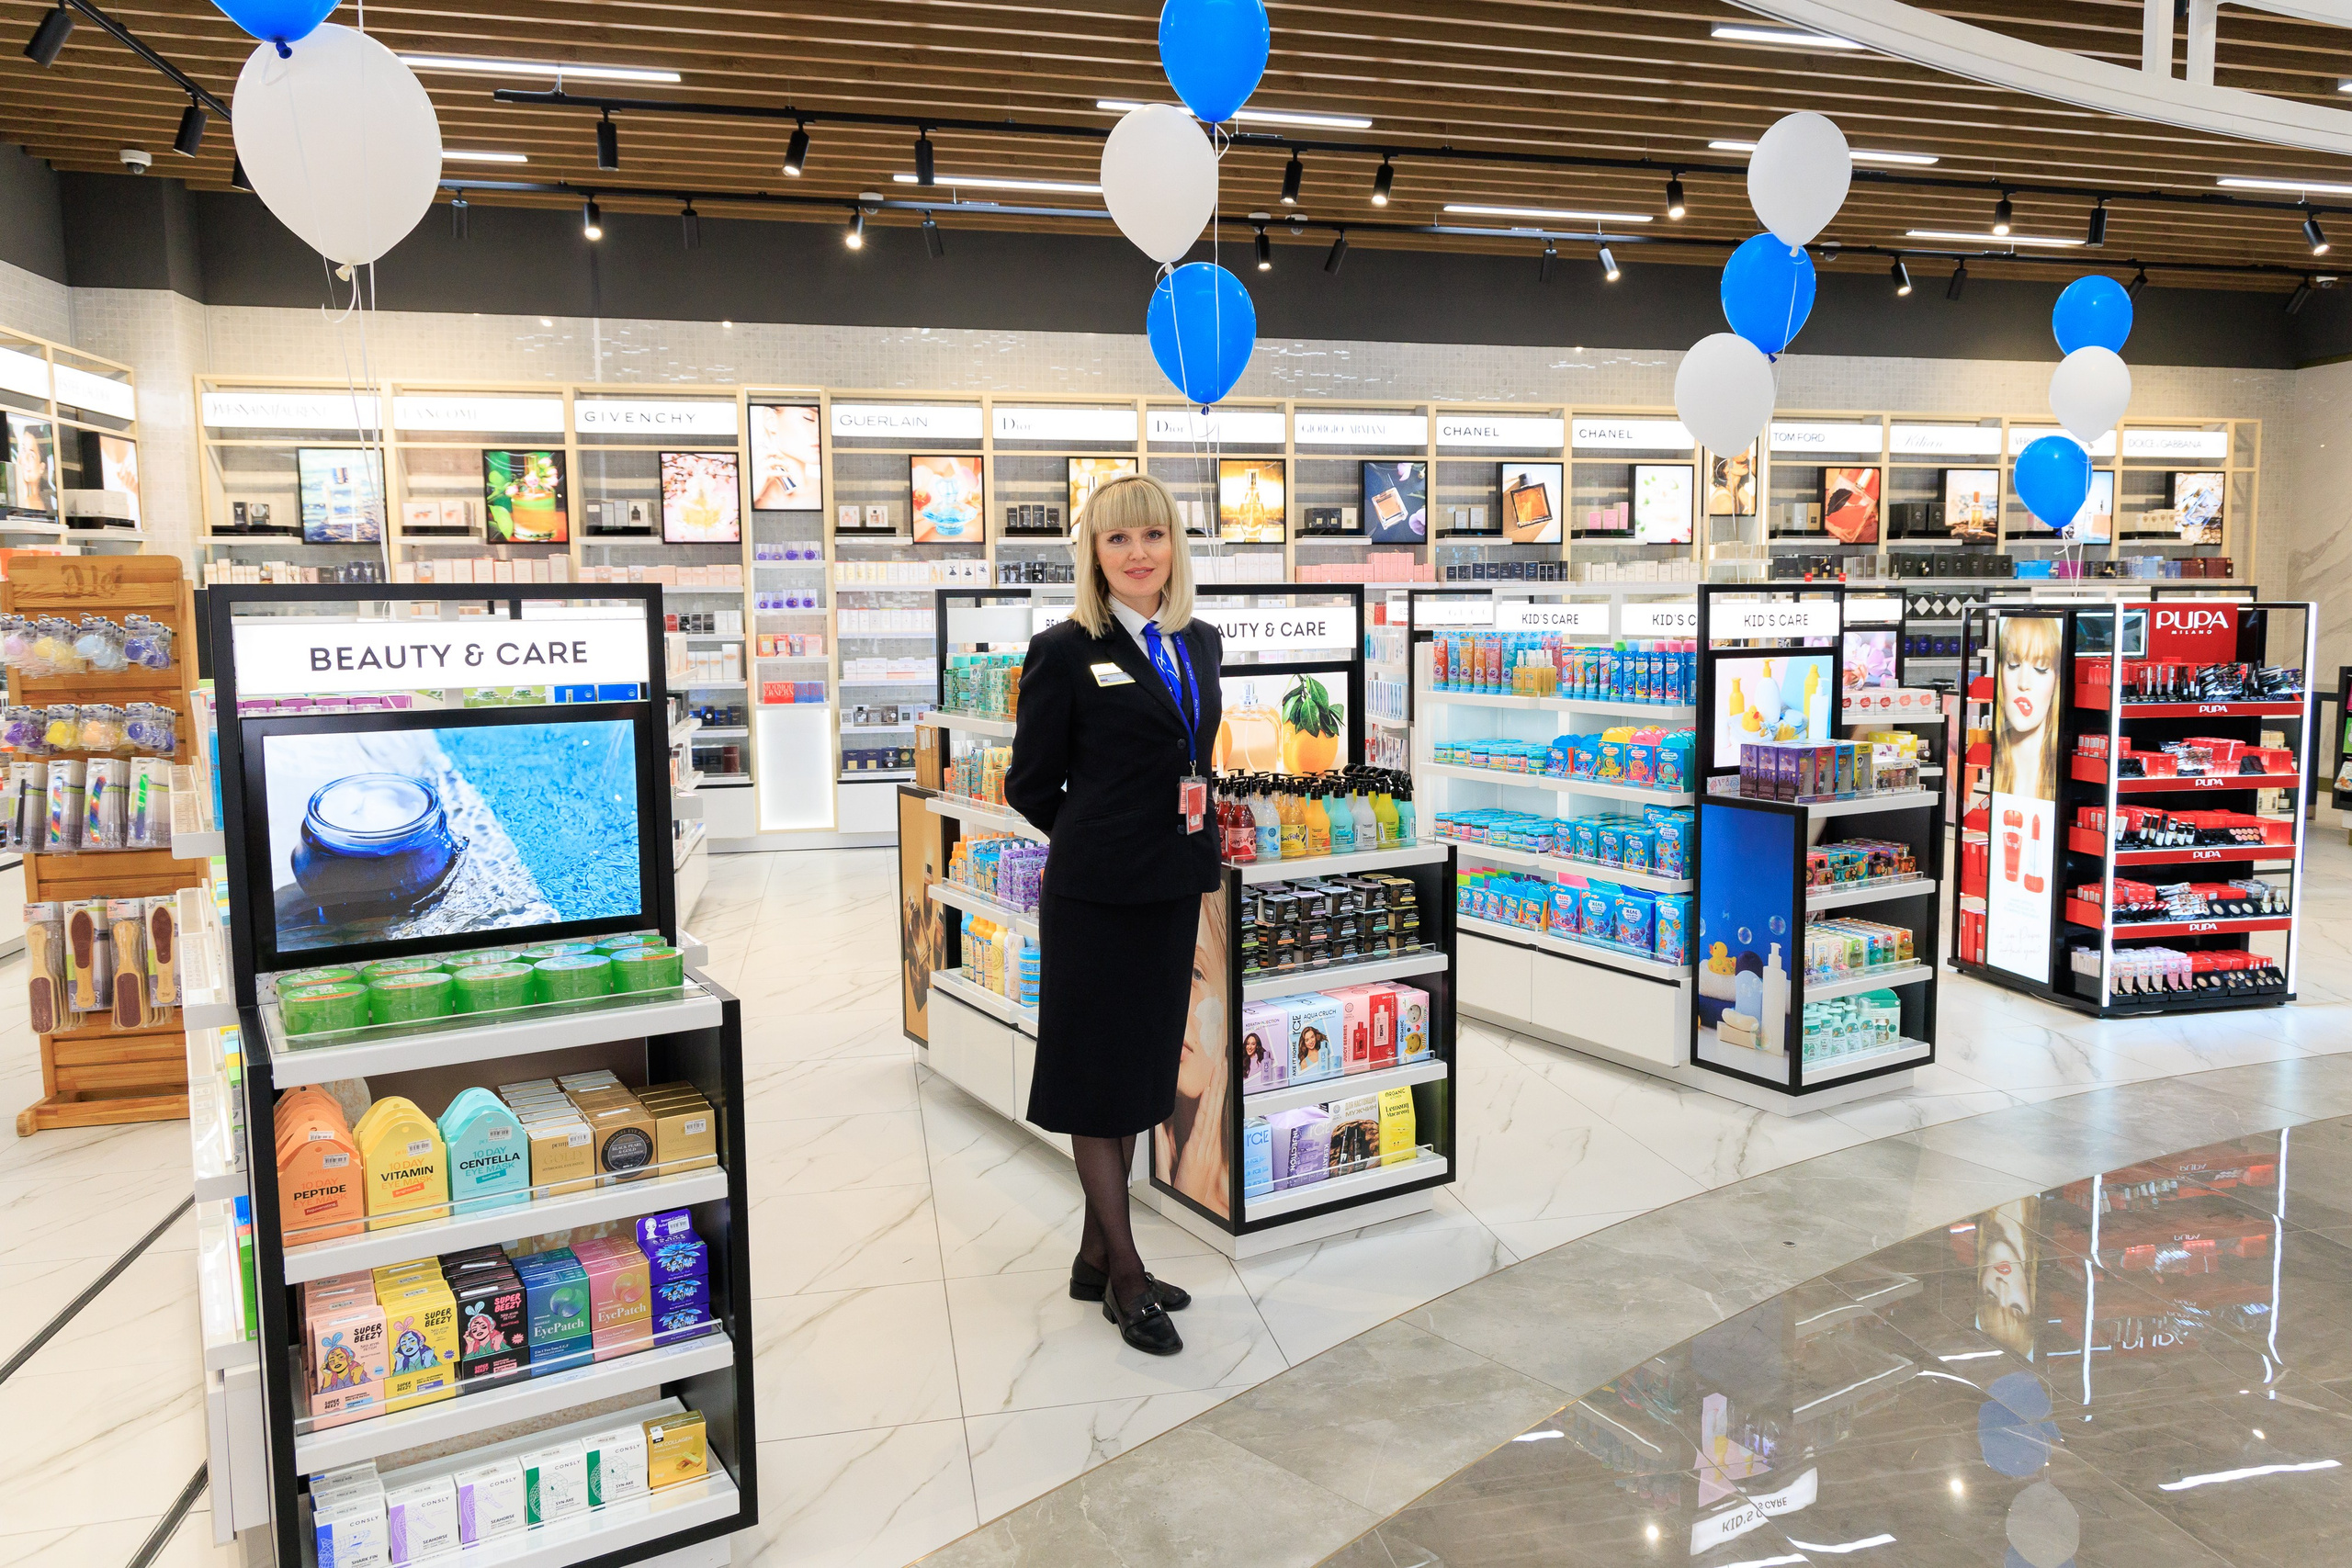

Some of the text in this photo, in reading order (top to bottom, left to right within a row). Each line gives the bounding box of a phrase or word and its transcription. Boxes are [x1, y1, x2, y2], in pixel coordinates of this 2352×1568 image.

[585, 412, 695, 424] GIVENCHY
[840, 414, 928, 428] GUERLAIN
[1002, 417, 1034, 431] Dior
[1156, 420, 1185, 433] Dior
[1301, 423, 1386, 434] GIORGIO ARMANI
[1442, 426, 1499, 437] CHANEL
[1578, 429, 1633, 439] CHANEL
[1772, 432, 1825, 444] TOM FORD
[2128, 438, 2202, 448] DOLCE GABBANA
[1521, 614, 1578, 625] KID'S CARE
[1652, 614, 1684, 626] KID'S
[1744, 614, 1808, 627] KID'S CARE
[2155, 610, 2230, 630] PUPA
[1216, 621, 1326, 638] AUTY & CARE
[311, 640, 588, 671] BEAUTY & CARE
[2199, 705, 2228, 714] PUPA
[2195, 777, 2224, 787] PUPA
[2192, 850, 2222, 860] PUPA
[2188, 922, 2218, 932] PUPA
[1303, 1011, 1318, 1021] AQUA
[1385, 1088, 1406, 1097] ORGANIC
[1345, 1103, 1377, 1117] МУЖЧИН
[472, 1145, 507, 1159] 10 DAY
[543, 1150, 582, 1165] GOLD
[1289, 1130, 1298, 1172] INJECTION
[390, 1157, 425, 1171] 10 DAY
[459, 1152, 521, 1170] CENTELLA
[380, 1165, 434, 1182] VITAMIN
[465, 1162, 515, 1177] EYE MASK
[301, 1177, 339, 1190] 10 DAY
[381, 1174, 434, 1190] EYE MASK
[293, 1184, 347, 1201] PEPTIDE
[292, 1193, 348, 1209] EYE MASK
[494, 1292, 521, 1305] SUPER
[494, 1300, 522, 1313] BEEZY
[424, 1307, 452, 1321] SUPER
[597, 1303, 647, 1324] EyePatch
[424, 1314, 453, 1327] BEEZY
[354, 1323, 382, 1336] SUPER
[534, 1318, 584, 1339] EyePatch
[354, 1330, 383, 1343] BEEZY
[663, 1436, 694, 1447] COLLAGEN
[615, 1443, 640, 1454] CONSLY
[554, 1460, 581, 1471] CONSLY
[490, 1476, 516, 1487] CONSLY
[616, 1480, 634, 1489] SYN-AKE
[421, 1495, 449, 1507] CONSLY
[555, 1496, 574, 1506] SYN-AKE
[349, 1515, 379, 1527] CONSLY
[490, 1513, 515, 1525] SEAHORSE
[422, 1533, 448, 1545] SEAHORSE
[351, 1556, 368, 1565] SHARK
